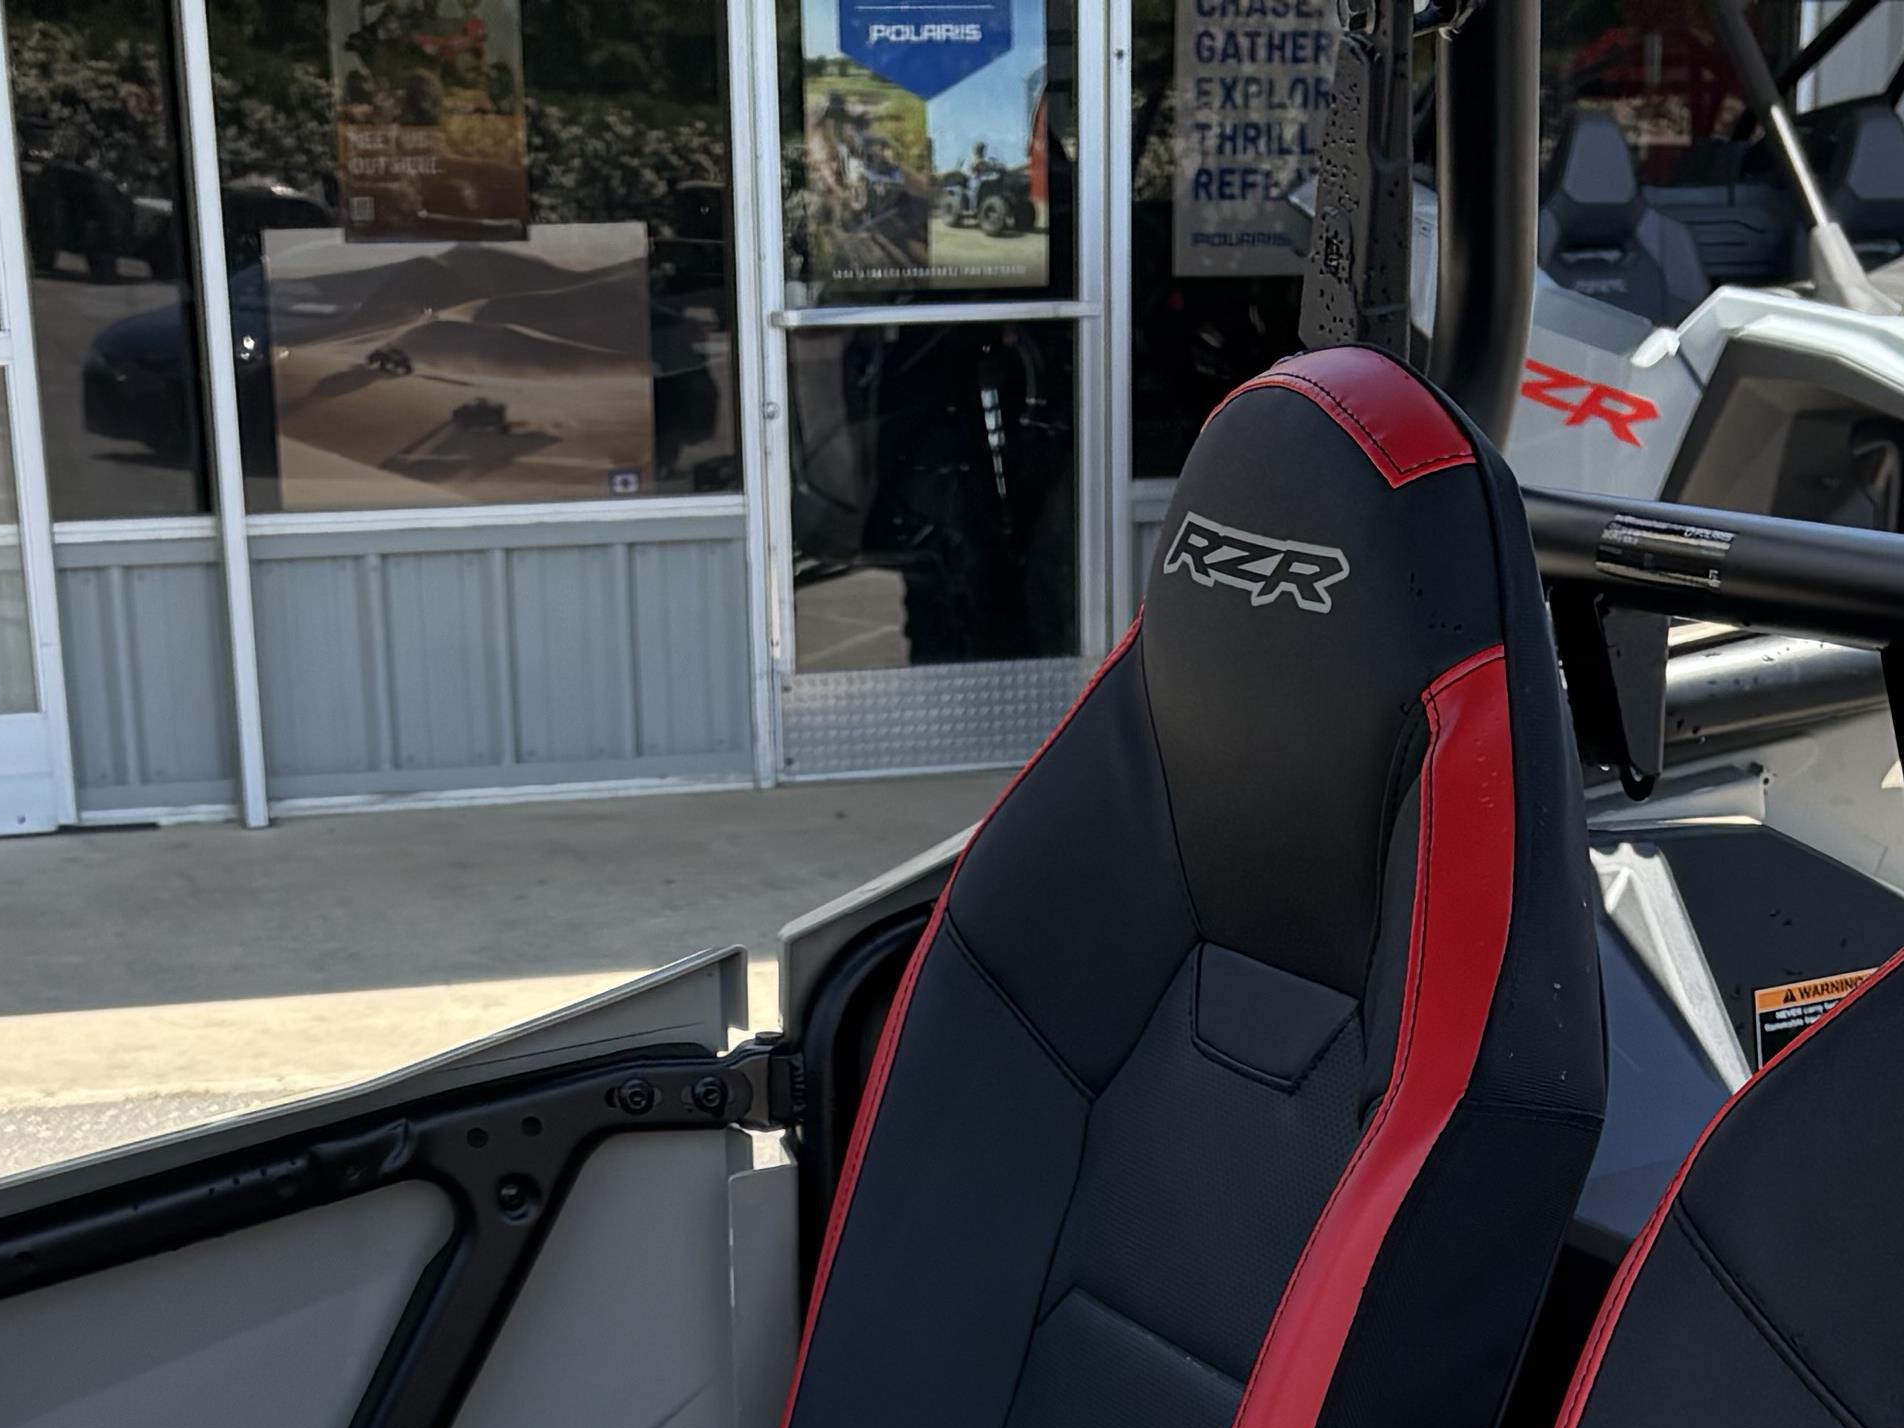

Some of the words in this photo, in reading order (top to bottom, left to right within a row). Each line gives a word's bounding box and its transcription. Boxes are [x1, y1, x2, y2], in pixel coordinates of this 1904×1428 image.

[867, 23, 983, 47] POLARIS
[1195, 77, 1331, 110] EXPLOR
[1193, 166, 1319, 201] REPE
[1520, 358, 1661, 447] ZR
[1163, 510, 1351, 614] RZR
